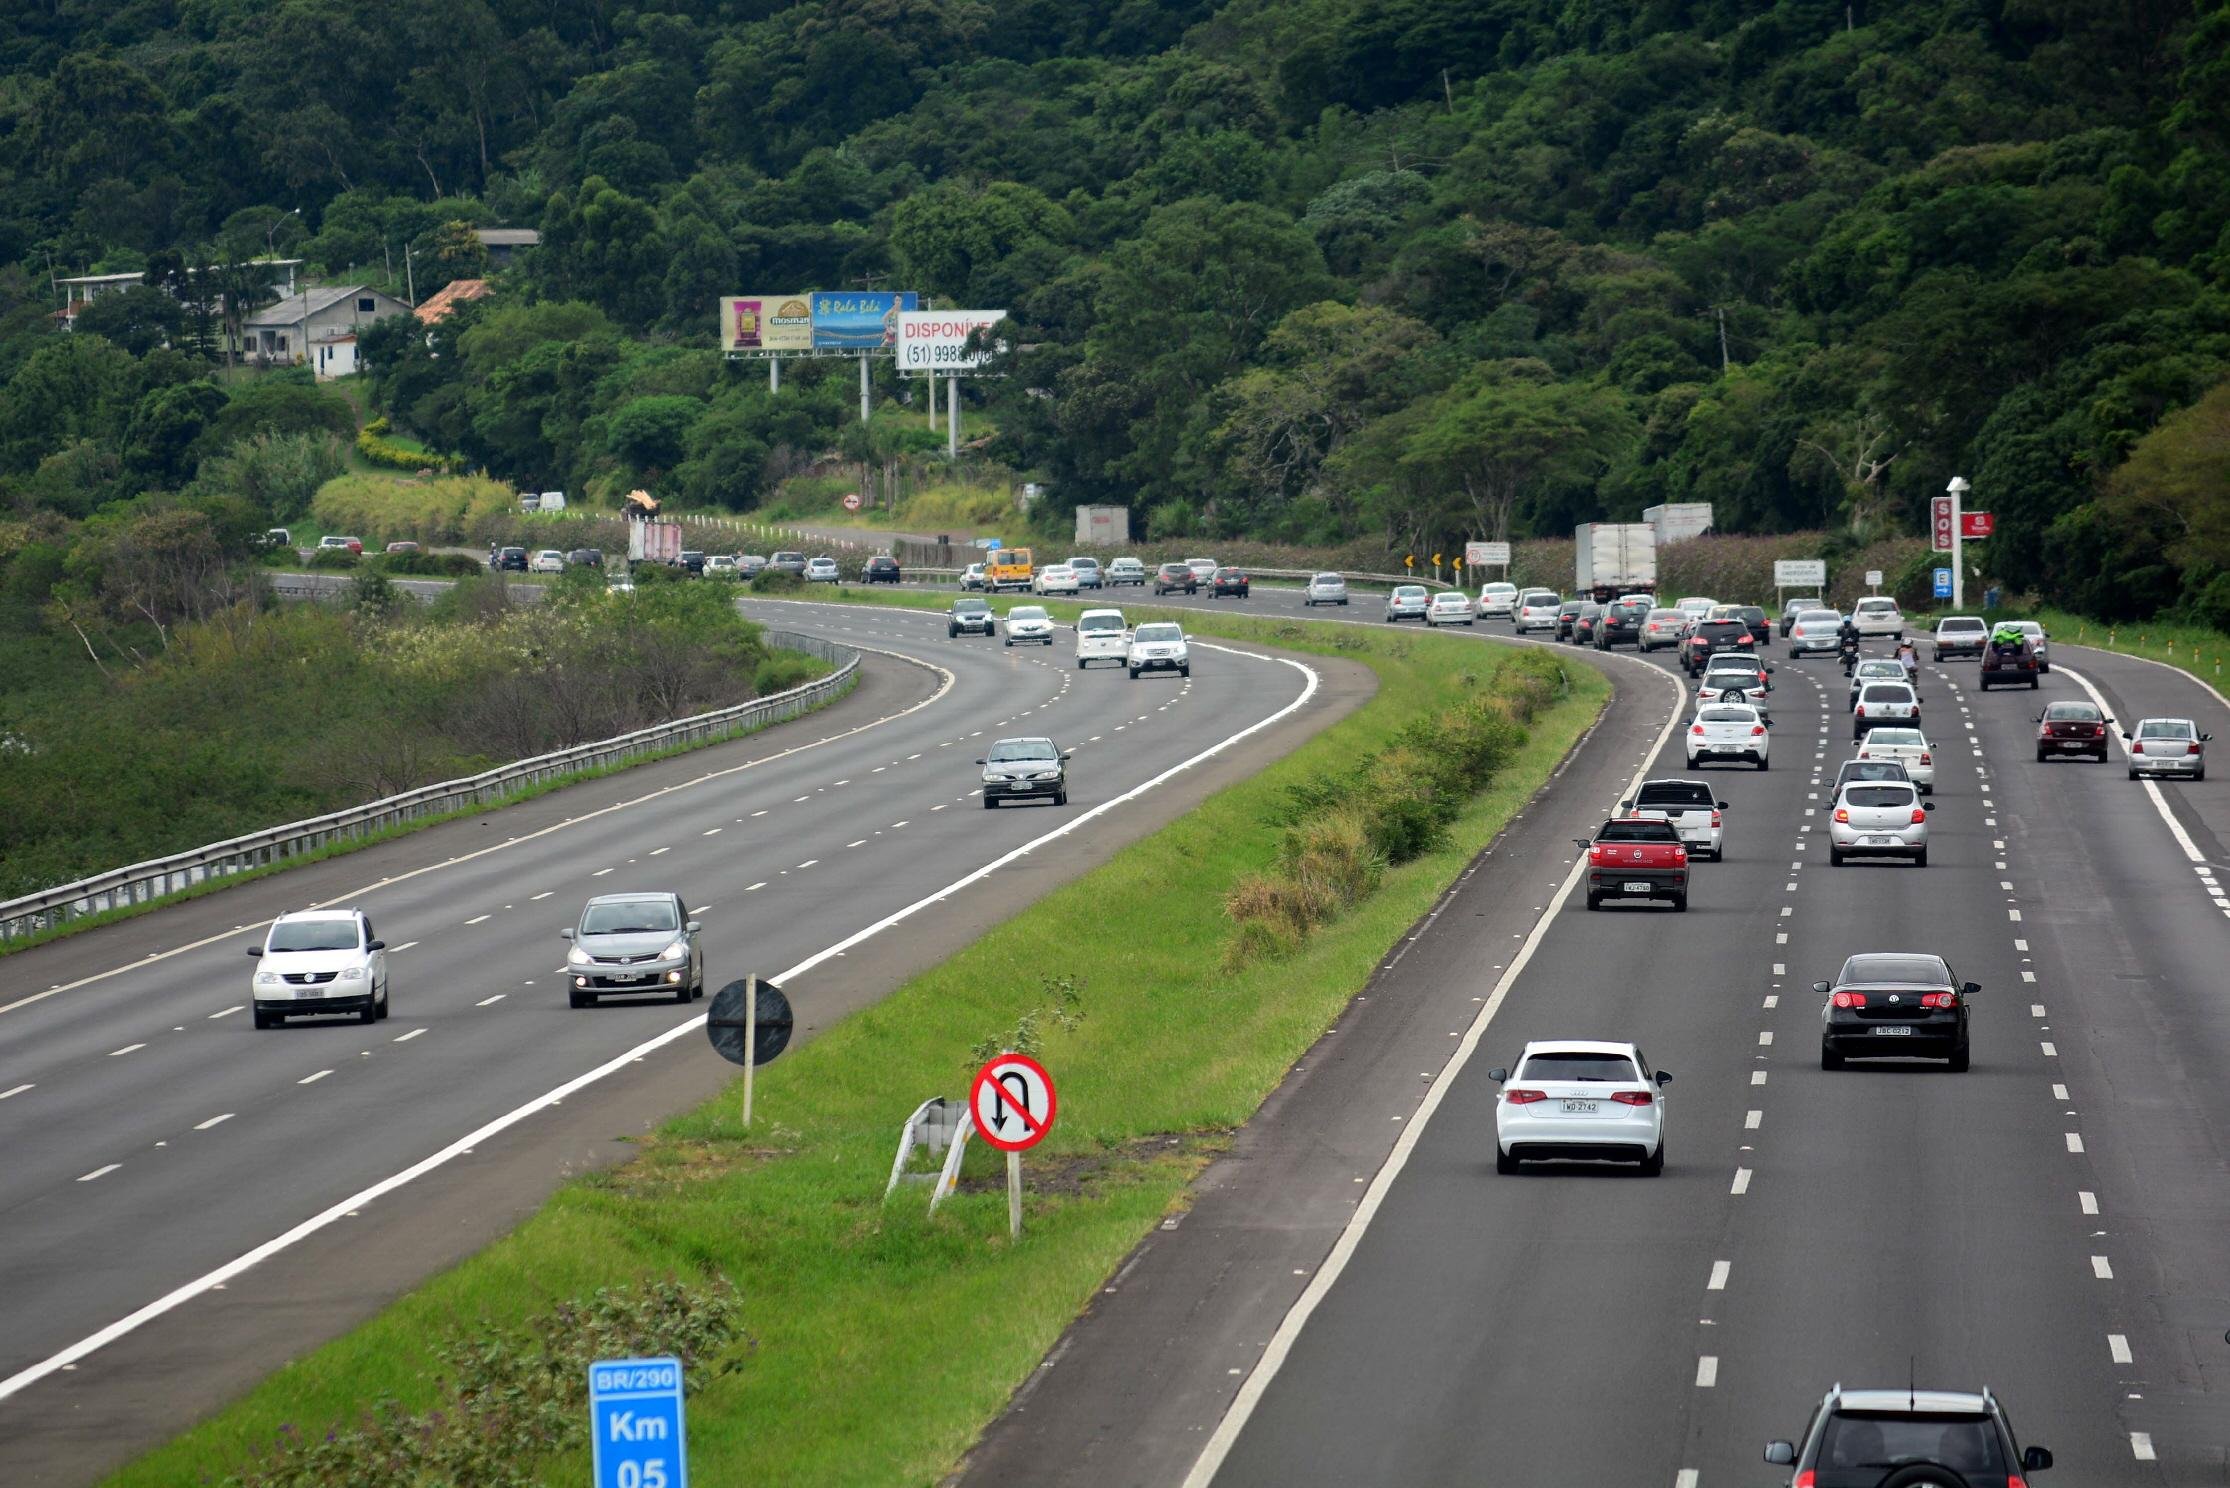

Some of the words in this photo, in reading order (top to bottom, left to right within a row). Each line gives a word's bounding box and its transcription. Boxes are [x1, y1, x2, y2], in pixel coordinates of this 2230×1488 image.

[907, 344, 931, 365] (51)
[1938, 502, 1951, 547] SOS
[596, 1368, 674, 1391] BR/290
[609, 1410, 668, 1442] Km
[616, 1458, 667, 1488] 05
